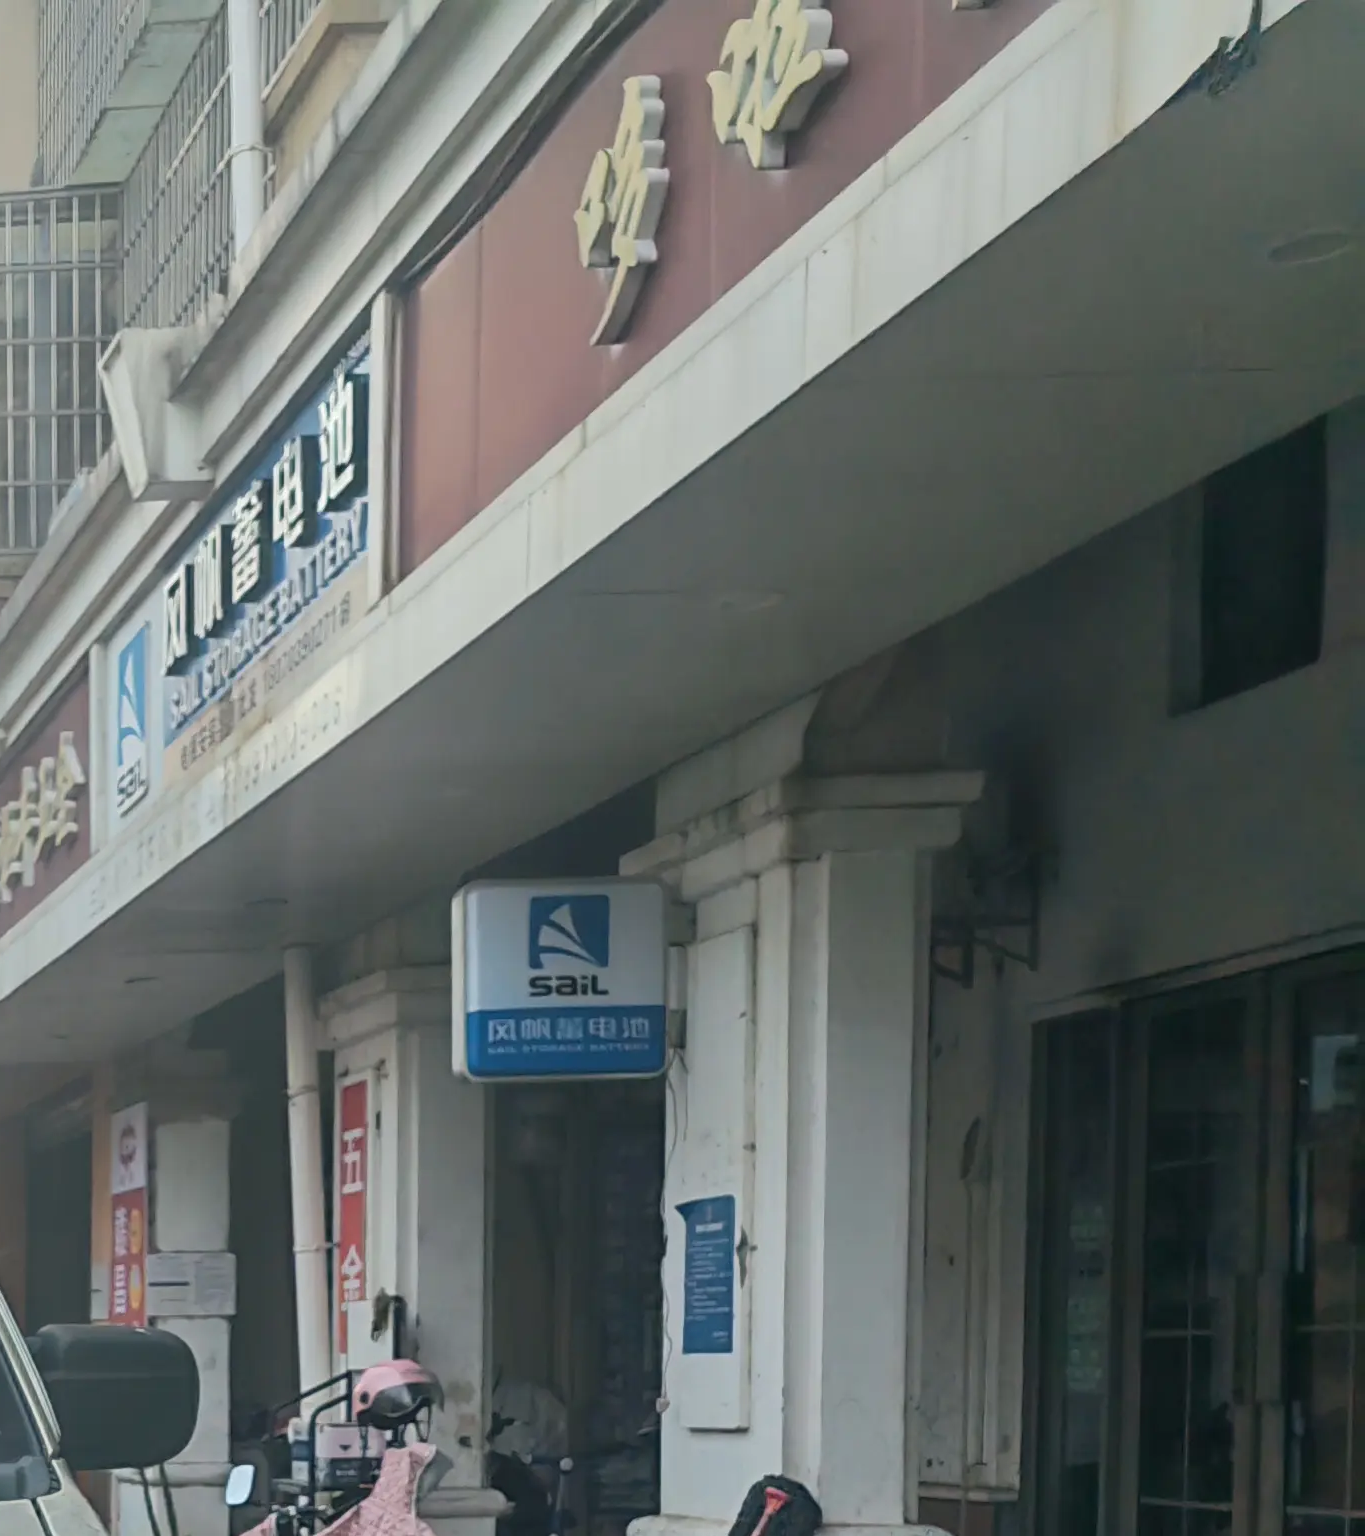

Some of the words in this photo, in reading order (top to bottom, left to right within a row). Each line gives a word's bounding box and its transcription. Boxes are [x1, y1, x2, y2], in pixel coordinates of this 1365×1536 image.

[162, 372, 356, 677] 风帆蓄电池
[488, 1016, 650, 1043] 风帆蓄电池
